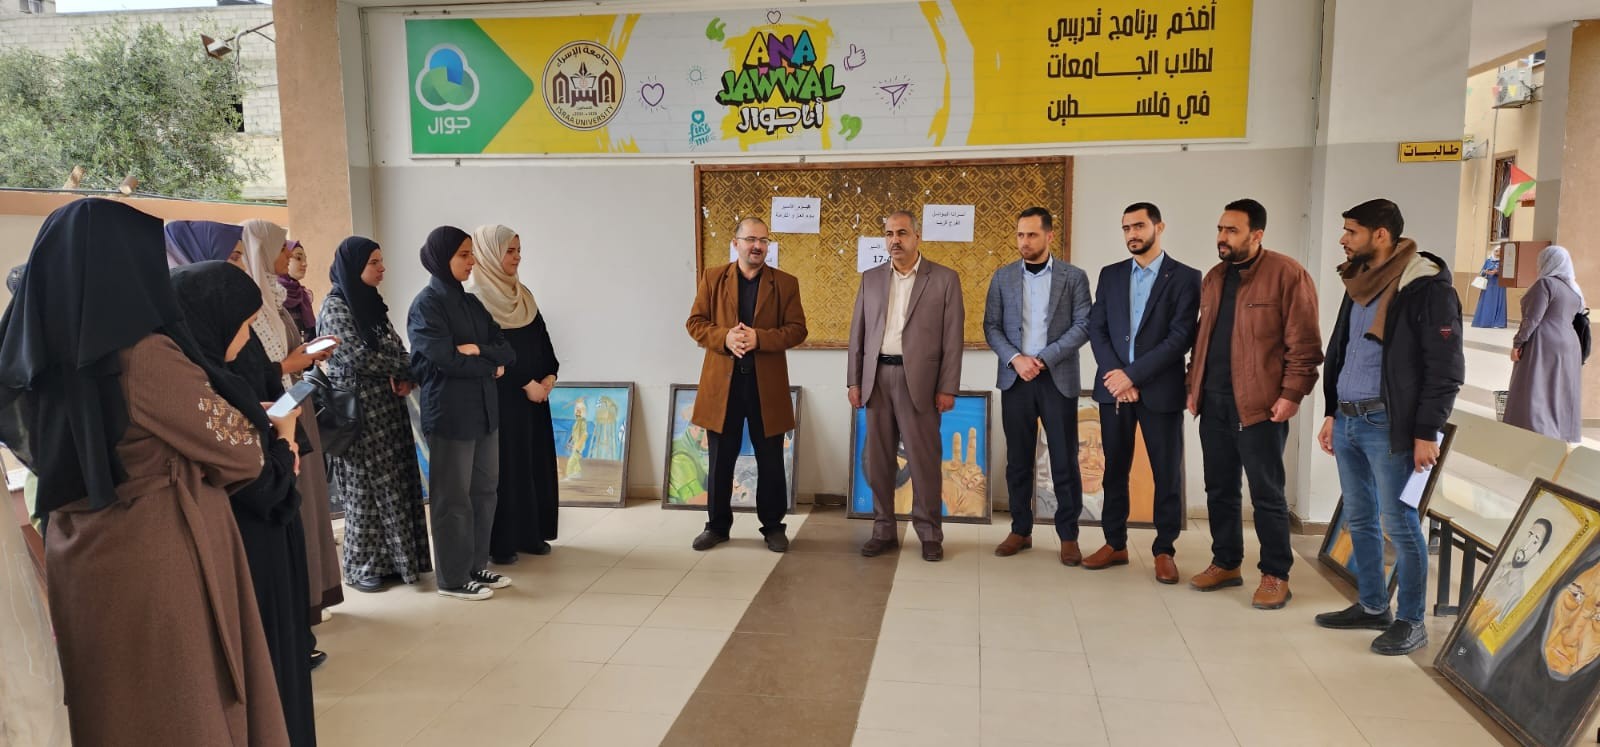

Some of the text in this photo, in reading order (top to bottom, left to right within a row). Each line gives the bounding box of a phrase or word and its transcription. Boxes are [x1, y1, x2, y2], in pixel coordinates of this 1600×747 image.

[1047, 0, 1217, 47] أضخم برنامج تدريبي
[582, 46, 609, 66] جامعة
[743, 29, 817, 68] ANA
[1047, 47, 1213, 80] لطلاب الجامعات
[715, 64, 846, 108] JAWWAL
[555, 105, 614, 126] ISRAA UNIVERSITY
[736, 97, 824, 135] أنا جوال
[1047, 90, 1210, 126] في فلسطين
[427, 116, 471, 135] جوال
[1403, 144, 1459, 159] طالبات
